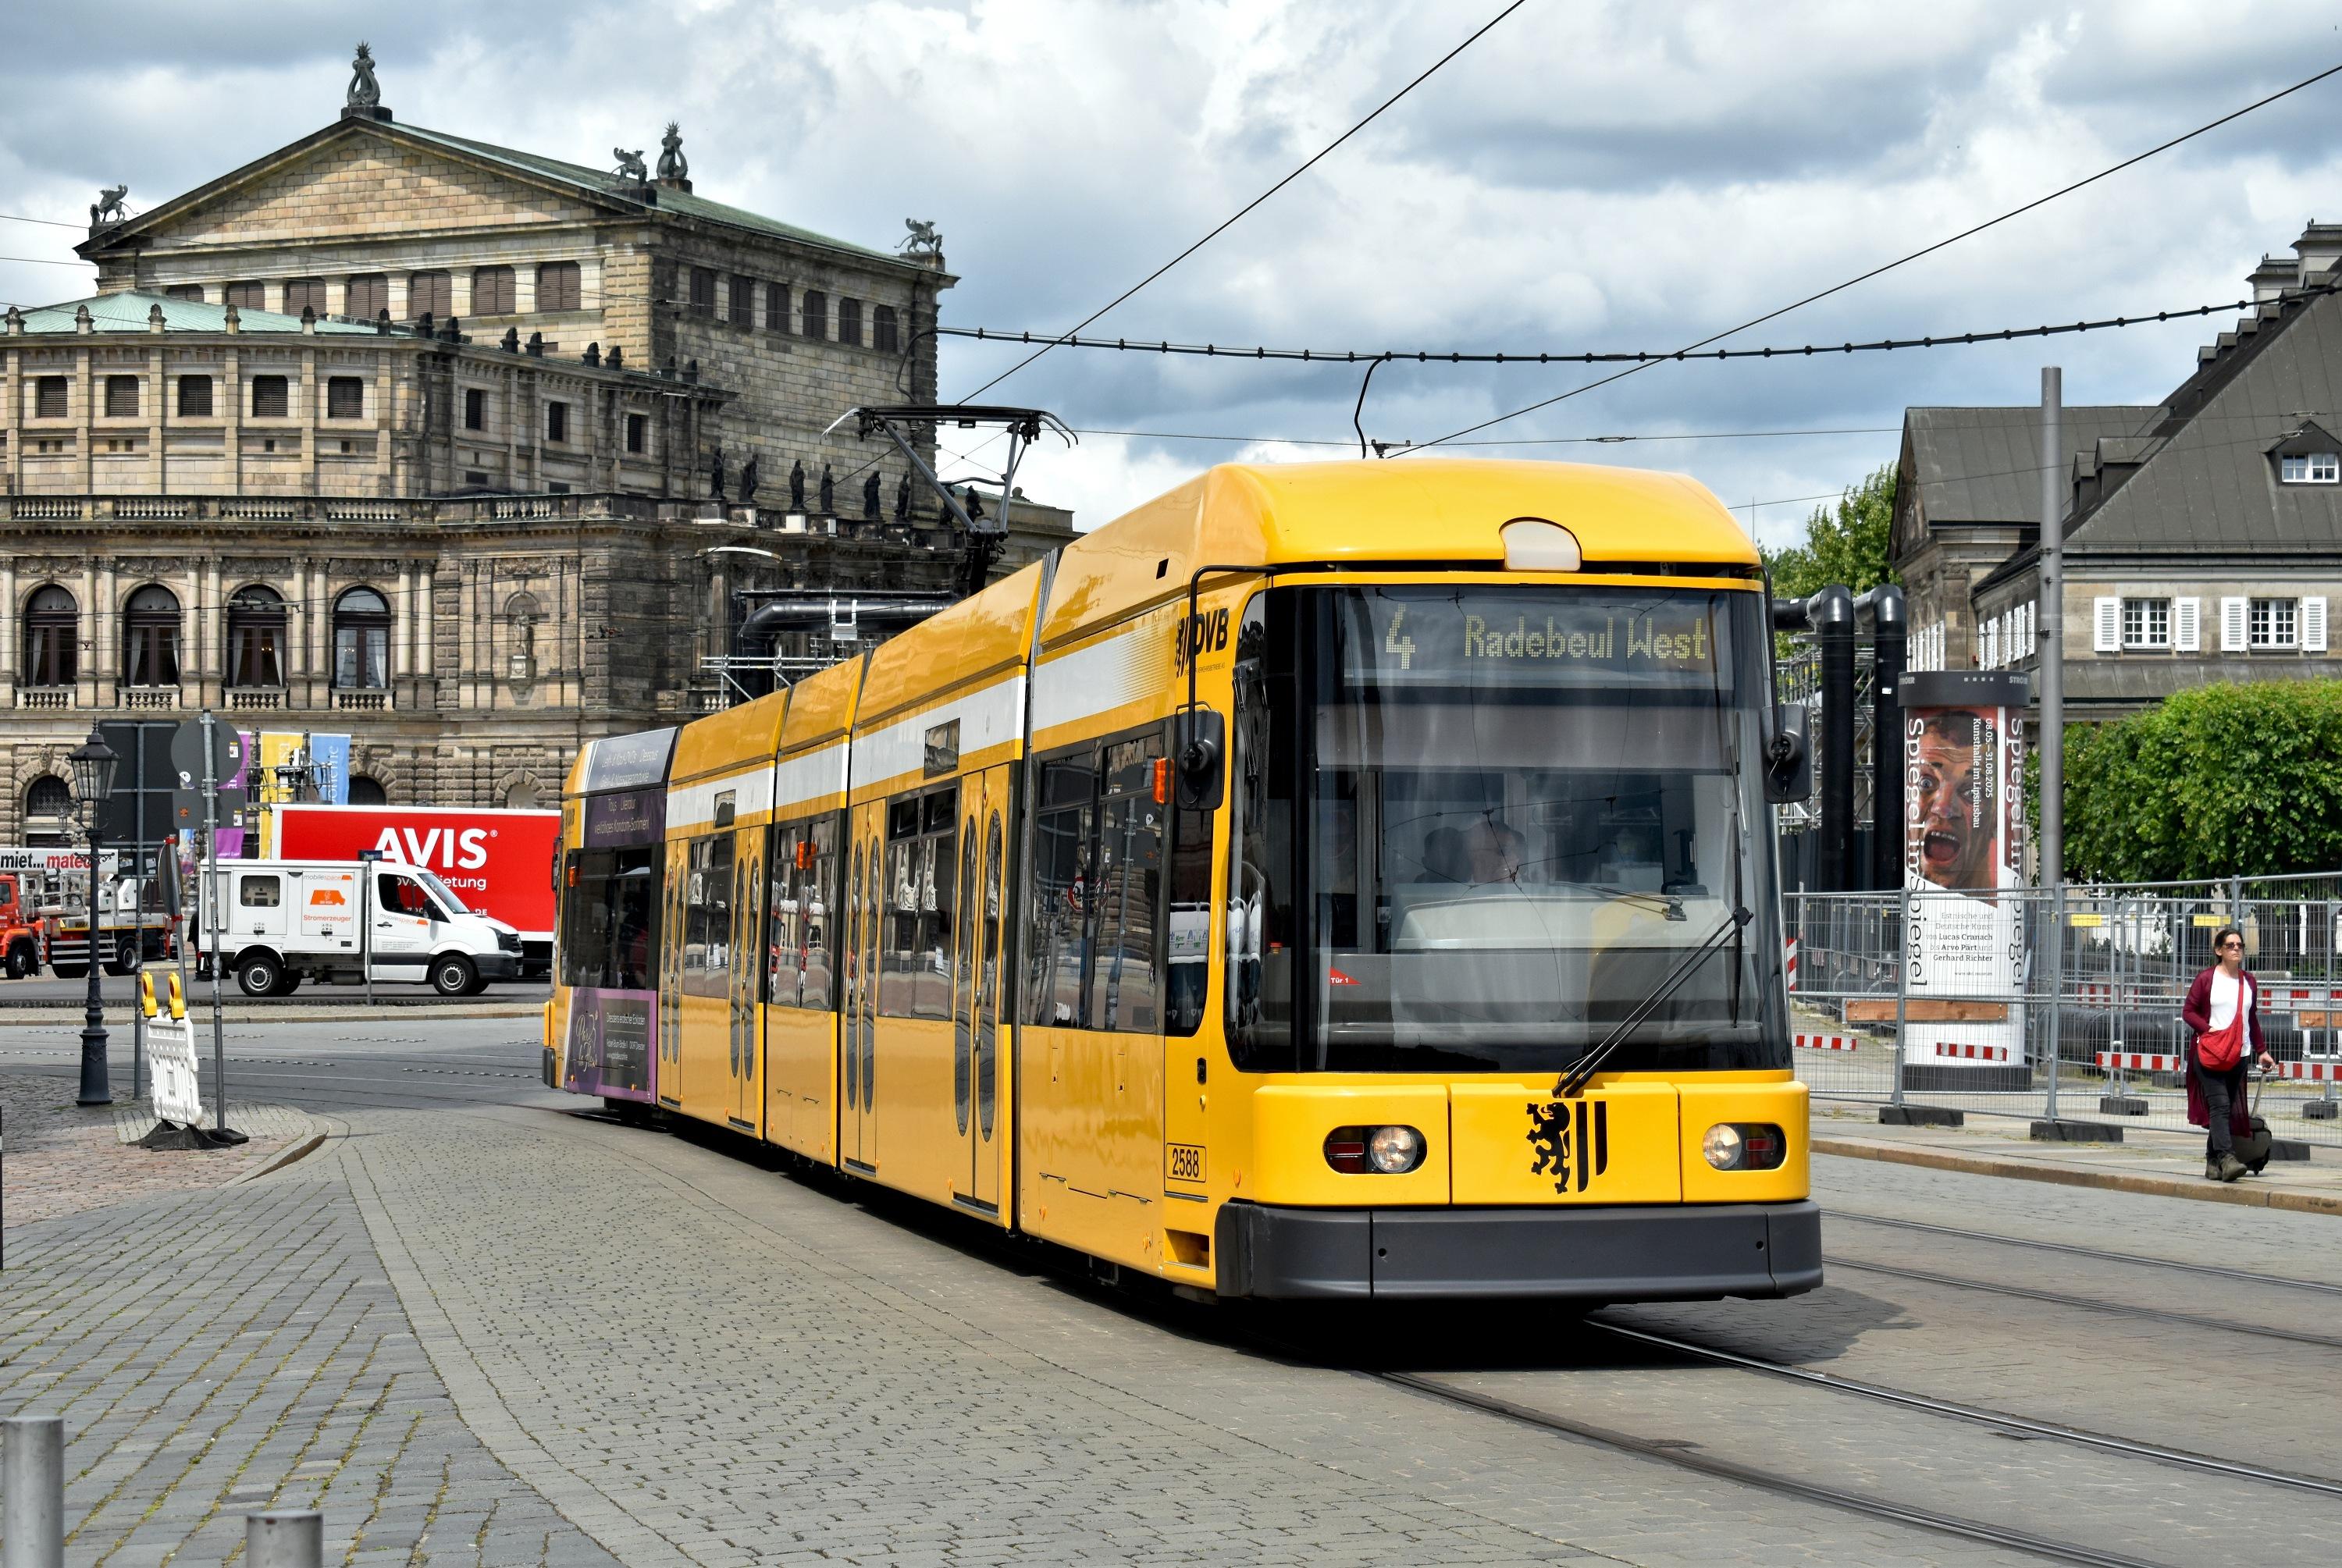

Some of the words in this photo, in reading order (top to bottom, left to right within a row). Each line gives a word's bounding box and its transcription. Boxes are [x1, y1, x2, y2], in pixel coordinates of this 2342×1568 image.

[1194, 608, 1229, 655] DVB
[1386, 603, 1415, 670] 4
[1465, 615, 1614, 659] Radebeul
[1627, 617, 1707, 660] West
[1973, 718, 1981, 765] Kunsthalle
[1906, 718, 1926, 830] Spiegel
[1973, 766, 1981, 780] im
[2006, 718, 2023, 830] Spiegel
[1908, 841, 1925, 876] im
[303, 914, 352, 923] Stromerzeuger
[1906, 876, 1927, 987] Spiegel
[1173, 1147, 1199, 1179] 2588
